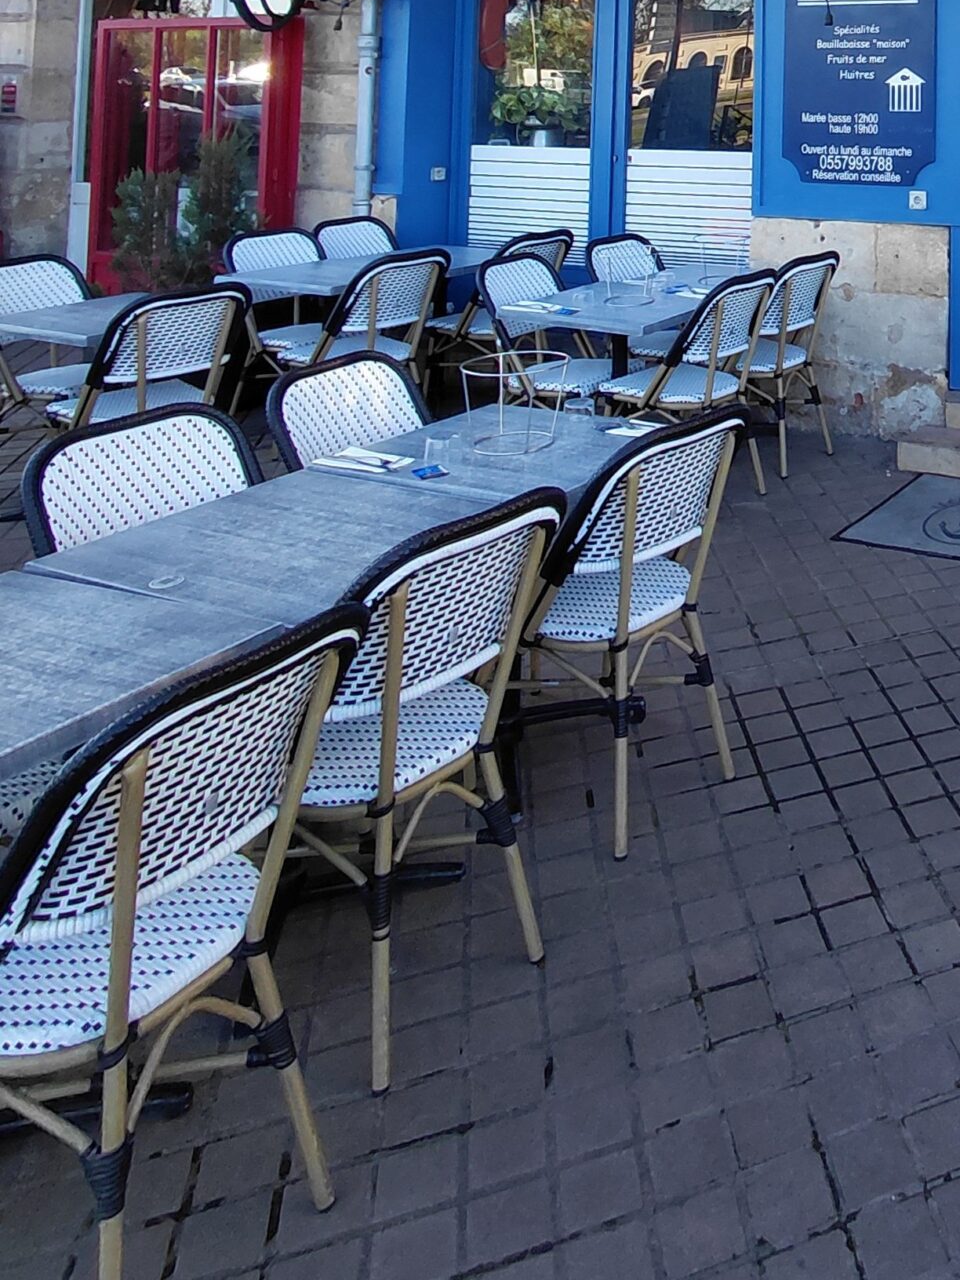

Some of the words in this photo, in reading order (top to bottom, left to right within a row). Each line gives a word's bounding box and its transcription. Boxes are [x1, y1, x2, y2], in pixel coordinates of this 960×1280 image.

[833, 23, 880, 37] Spécialités
[816, 39, 871, 49] Bouillabaisse
[872, 38, 910, 49] "maison"
[826, 53, 854, 64] Fruits
[855, 53, 868, 64] de
[868, 54, 887, 64] mer
[801, 112, 827, 123] Marée
[828, 113, 852, 123] basse
[854, 113, 879, 124] 12h00
[829, 124, 852, 134] haute
[854, 124, 879, 135] 19h00
[801, 143, 828, 155] Ouvert
[828, 145, 839, 155] du
[840, 145, 859, 155] lundi
[860, 147, 871, 156] au
[873, 146, 913, 157] dimanche
[819, 155, 893, 171] 0557993788
[812, 169, 859, 181] Réservation
[860, 172, 902, 183] conseillée
